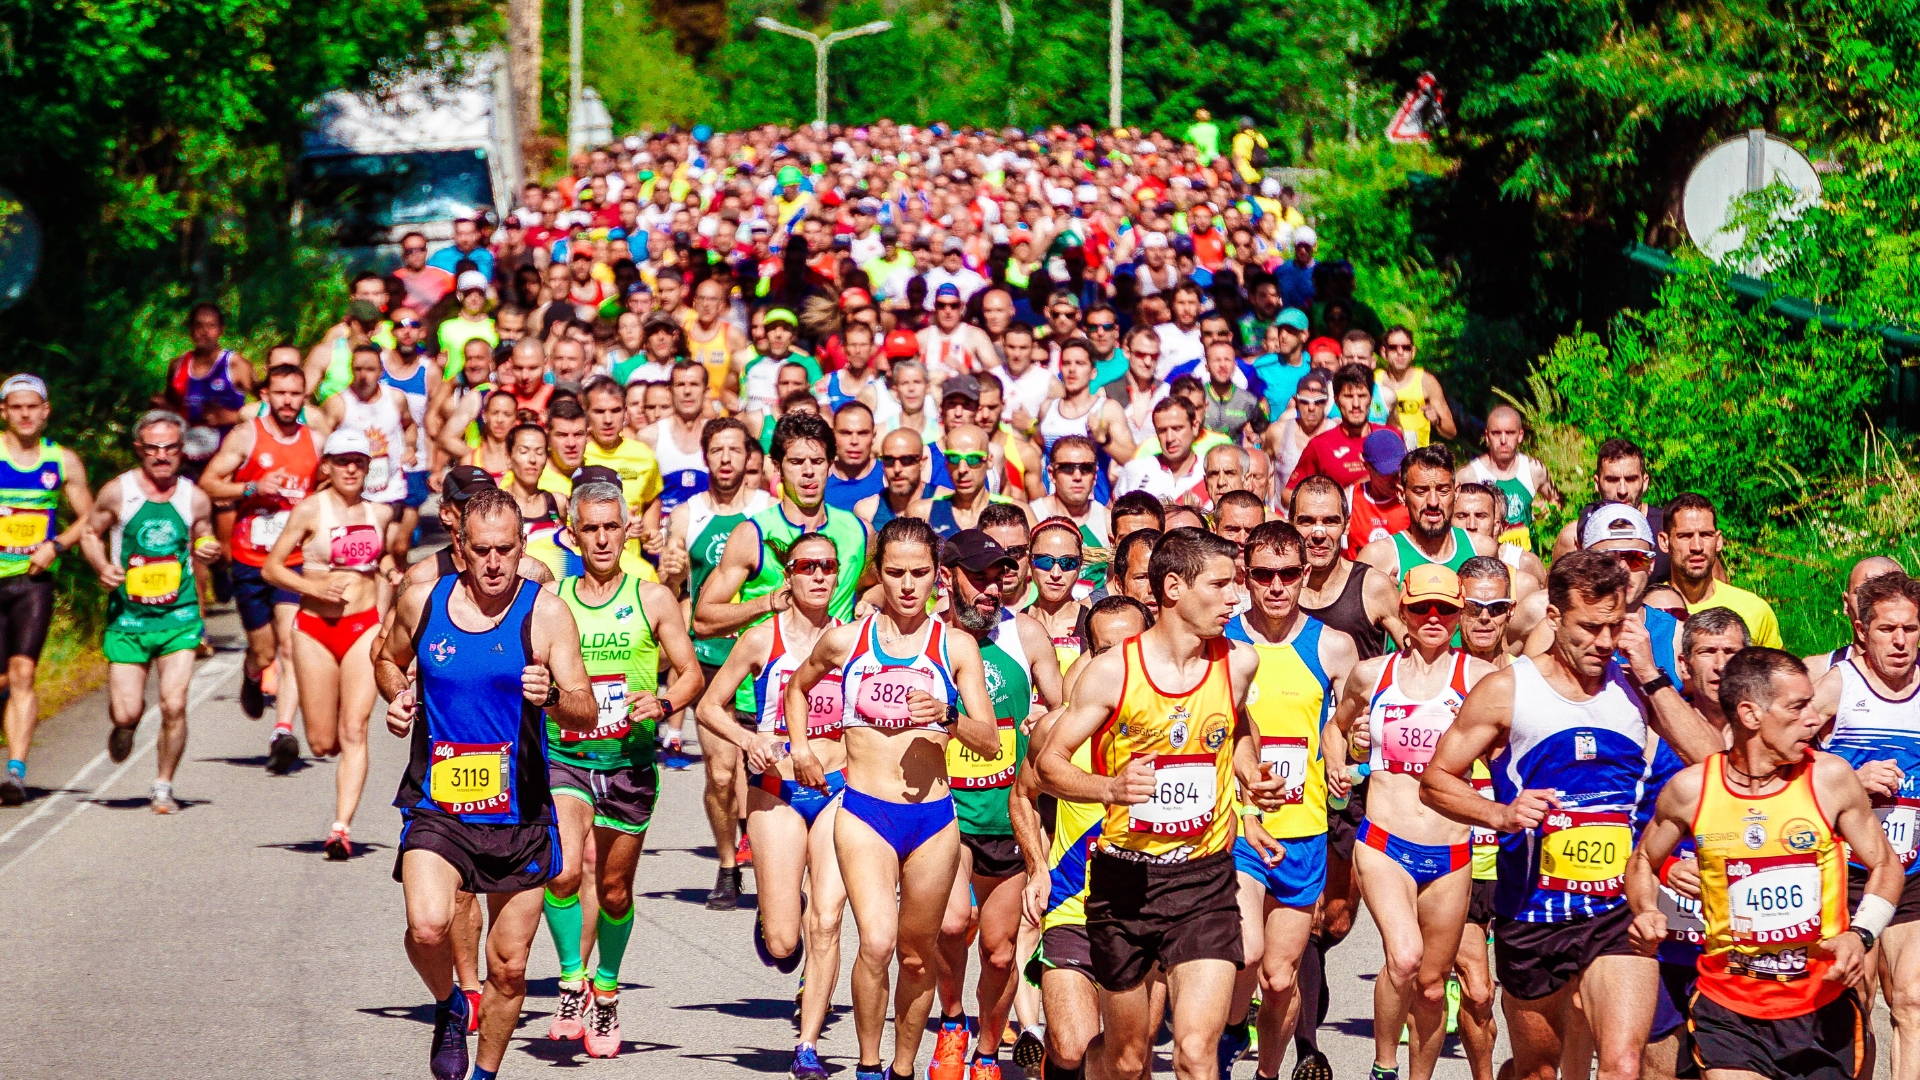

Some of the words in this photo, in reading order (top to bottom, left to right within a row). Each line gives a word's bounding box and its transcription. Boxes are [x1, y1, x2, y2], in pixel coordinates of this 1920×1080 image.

[341, 541, 372, 558] 4685
[1386, 706, 1407, 720] edp
[1398, 727, 1442, 749] 3827
[434, 744, 454, 760] edp
[959, 742, 1004, 762] 406
[451, 767, 490, 787] 3119
[966, 765, 1015, 787] DOURO
[1262, 760, 1290, 779] 10
[1403, 761, 1430, 774] DO
[452, 792, 509, 812] DOURO
[1149, 782, 1200, 804] 4684
[1152, 811, 1213, 835] DOURO
[1546, 812, 1573, 831] edp
[1562, 839, 1616, 865] 4620
[1746, 884, 1804, 911] 4686
[1756, 913, 1821, 943] DOURO
